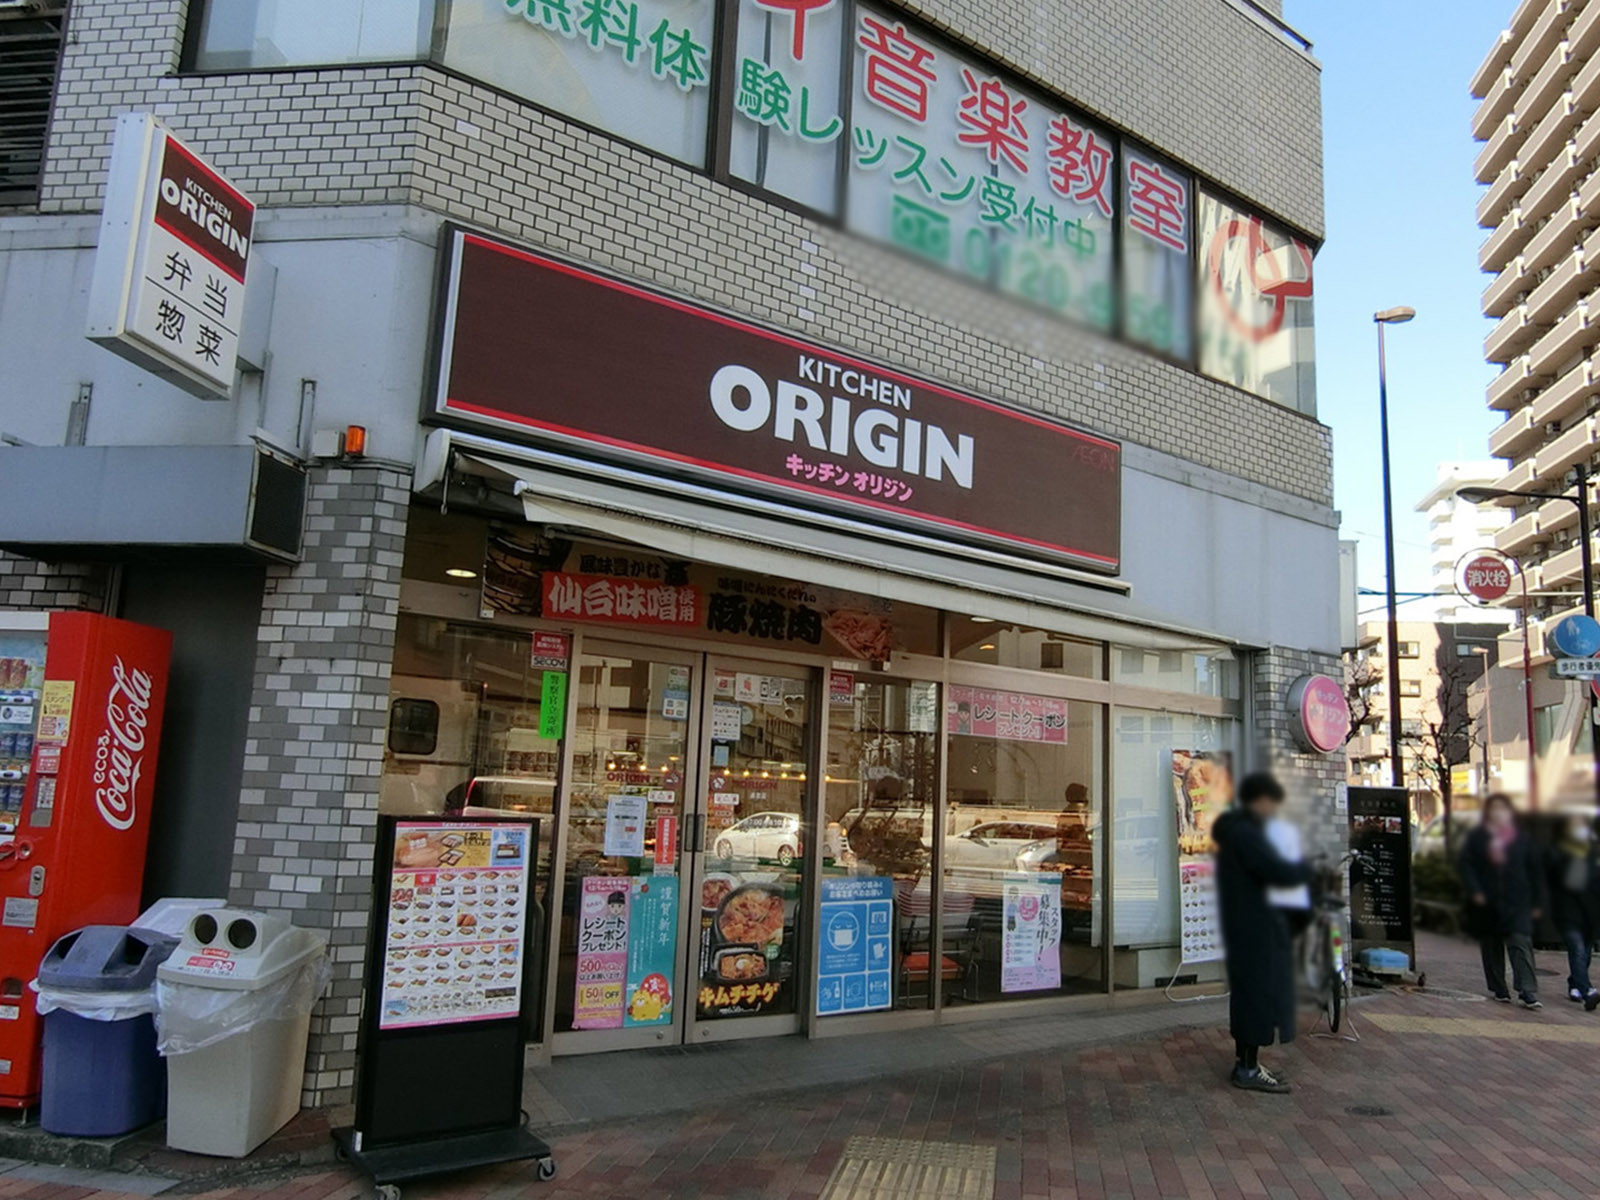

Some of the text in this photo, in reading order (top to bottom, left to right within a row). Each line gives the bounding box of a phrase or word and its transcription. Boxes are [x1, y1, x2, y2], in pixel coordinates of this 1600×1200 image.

[858, 16, 1188, 254] 音楽教室
[160, 177, 248, 260] ORIGIN
[185, 176, 233, 221] KITCHEN
[164, 250, 229, 320] 弁当
[156, 299, 222, 367] 惣菜
[798, 354, 911, 411] KITCHEN
[709, 363, 974, 489] ORIGIN
[785, 453, 914, 502] キッチン オリジン
[548, 574, 678, 622] 仙台味噌
[1467, 569, 1508, 588] 消火栓
[95, 654, 152, 830] Coca-Cola
[582, 928, 627, 943] クーポン
[583, 916, 626, 930] レシート
[579, 960, 602, 973] 500
[604, 991, 620, 999] OFF
